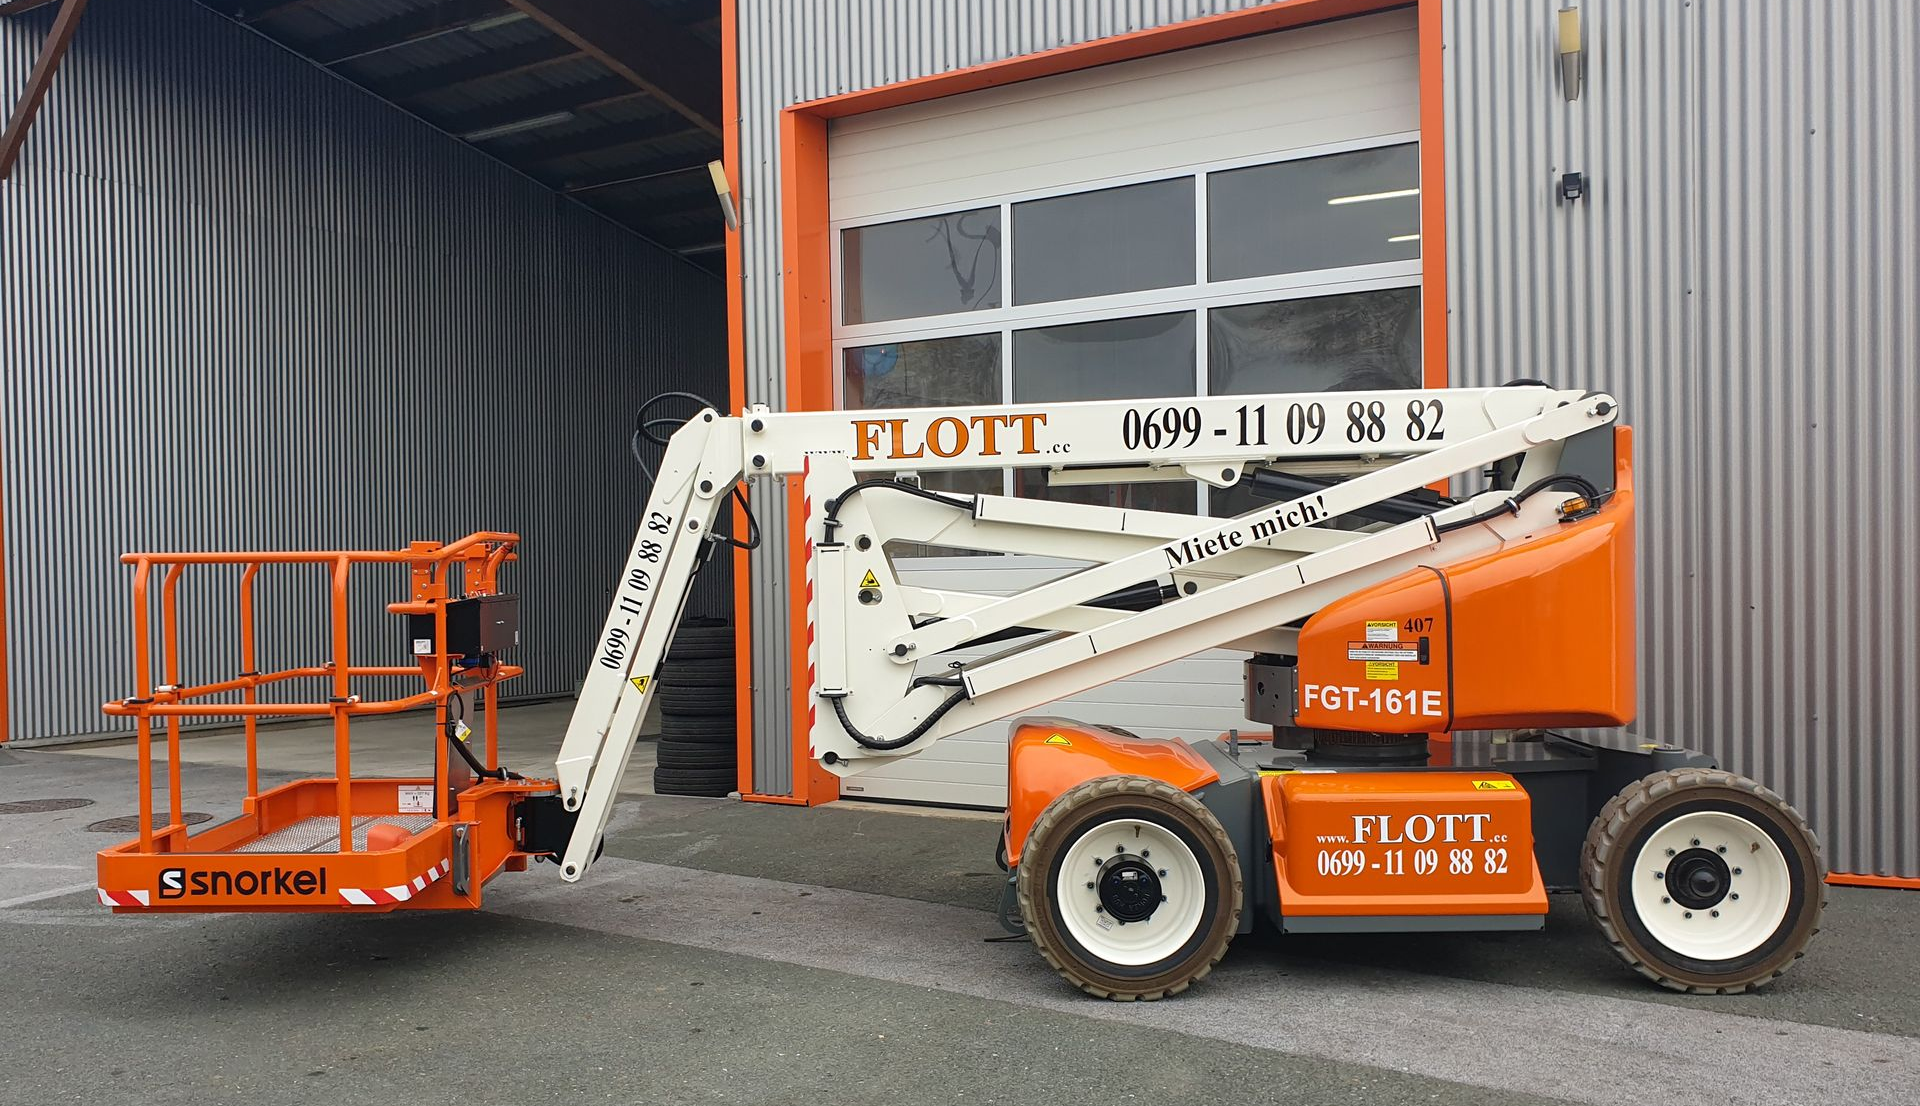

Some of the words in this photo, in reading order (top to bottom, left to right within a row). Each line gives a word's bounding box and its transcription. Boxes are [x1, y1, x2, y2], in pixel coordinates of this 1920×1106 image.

[804, 413, 1071, 460] FLOTT.cc
[1122, 406, 1202, 450] 0699
[1235, 404, 1269, 447] 11
[1286, 402, 1326, 445] 09
[1346, 400, 1386, 443] 88
[1406, 399, 1445, 442] 82
[648, 512, 673, 535] 82
[1163, 530, 1244, 570] Miete
[1250, 495, 1329, 541] mich!
[637, 539, 663, 563] 88
[627, 568, 651, 591] 09
[619, 595, 644, 617] 11
[1403, 617, 1434, 633] 407
[599, 627, 631, 670] 0699
[1304, 684, 1442, 717] FGT-161E
[1317, 849, 1366, 876] 0699
[1414, 848, 1439, 875] 09
[1449, 848, 1473, 875] 88
[1484, 847, 1508, 874] 82
[190, 867, 326, 895] snorkel
